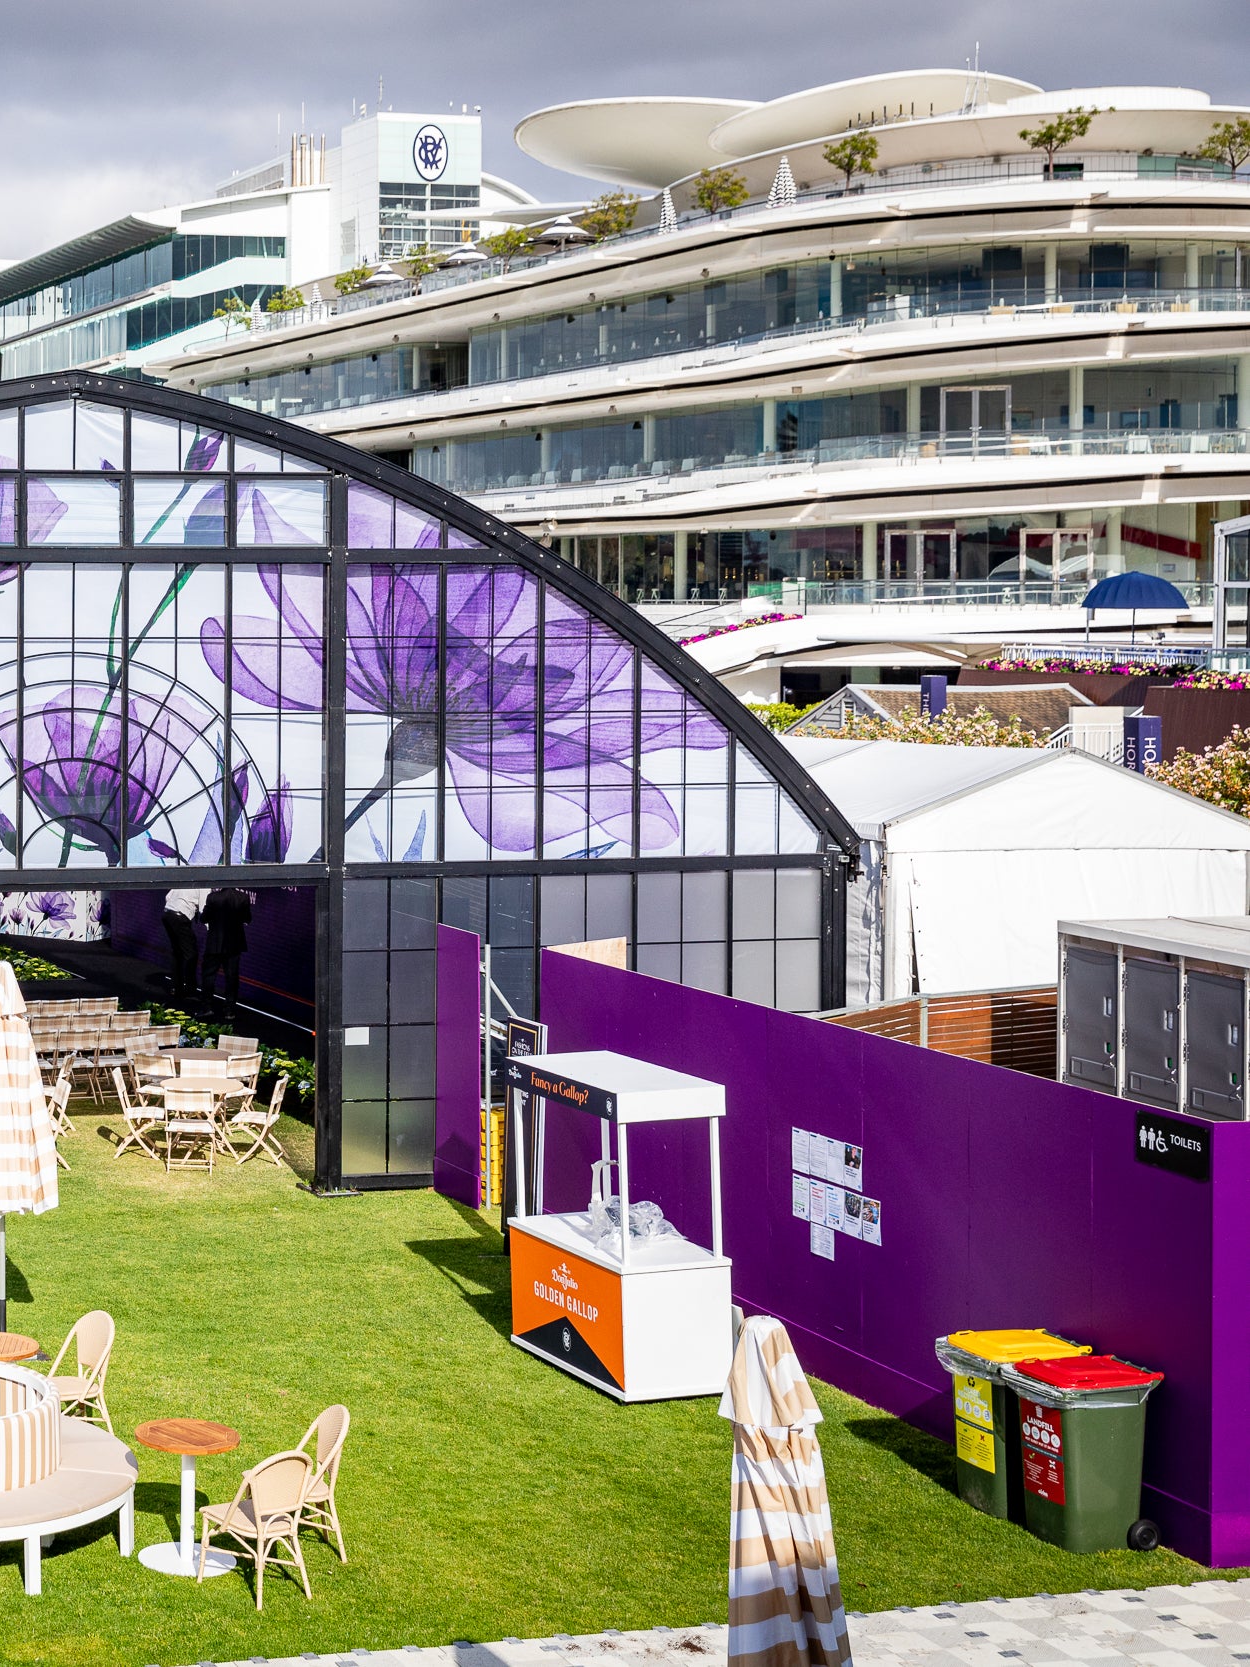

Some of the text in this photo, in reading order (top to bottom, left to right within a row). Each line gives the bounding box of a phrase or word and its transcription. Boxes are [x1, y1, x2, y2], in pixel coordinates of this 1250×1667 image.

[531, 1072, 589, 1106] Fancy a Gallop?
[1170, 1134, 1202, 1152] TOILETS
[534, 1281, 598, 1322] GOLDEN GALLOP
[1026, 1415, 1055, 1433] LANDFILL
